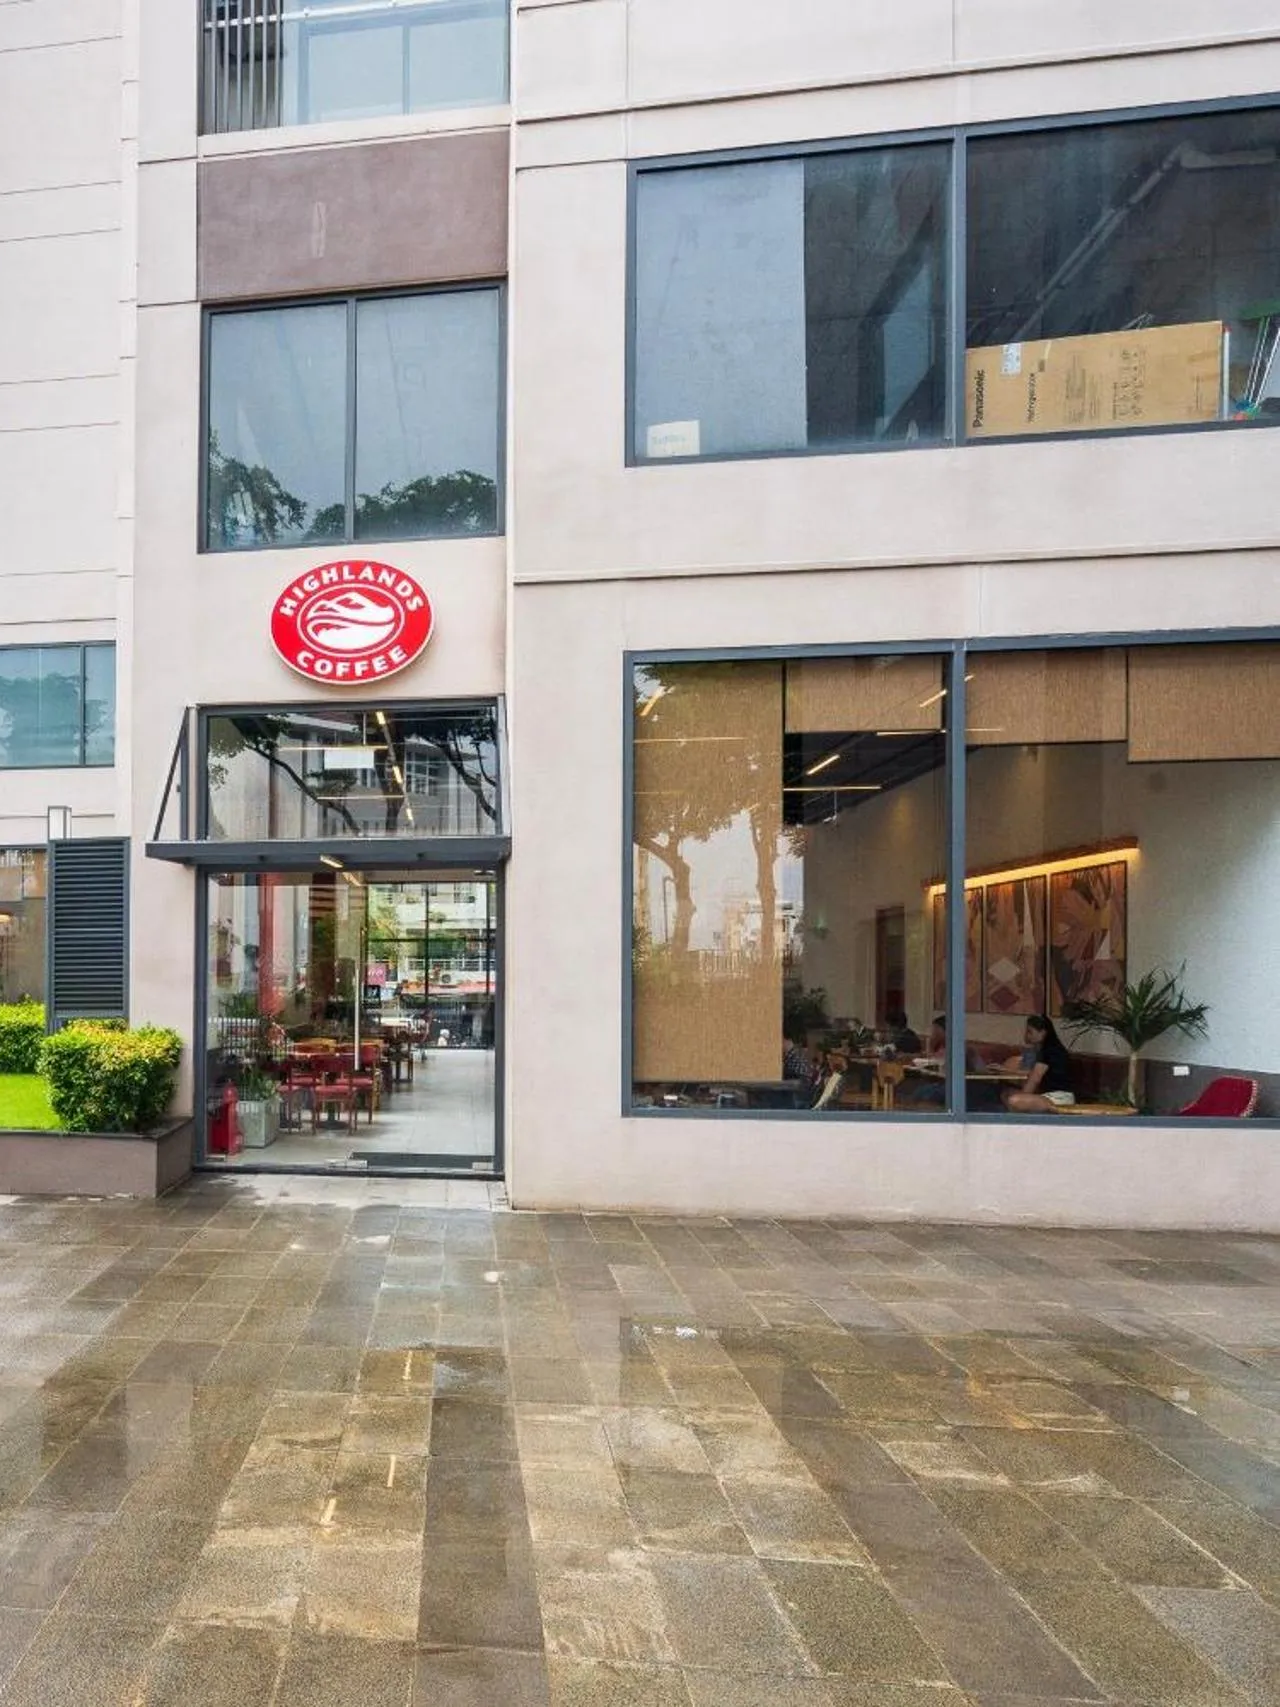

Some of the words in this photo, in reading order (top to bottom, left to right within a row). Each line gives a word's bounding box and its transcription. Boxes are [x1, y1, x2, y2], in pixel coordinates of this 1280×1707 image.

[972, 369, 985, 428] Panasonic
[279, 564, 424, 617] HIGHLANDS
[296, 644, 407, 678] COFFEE
